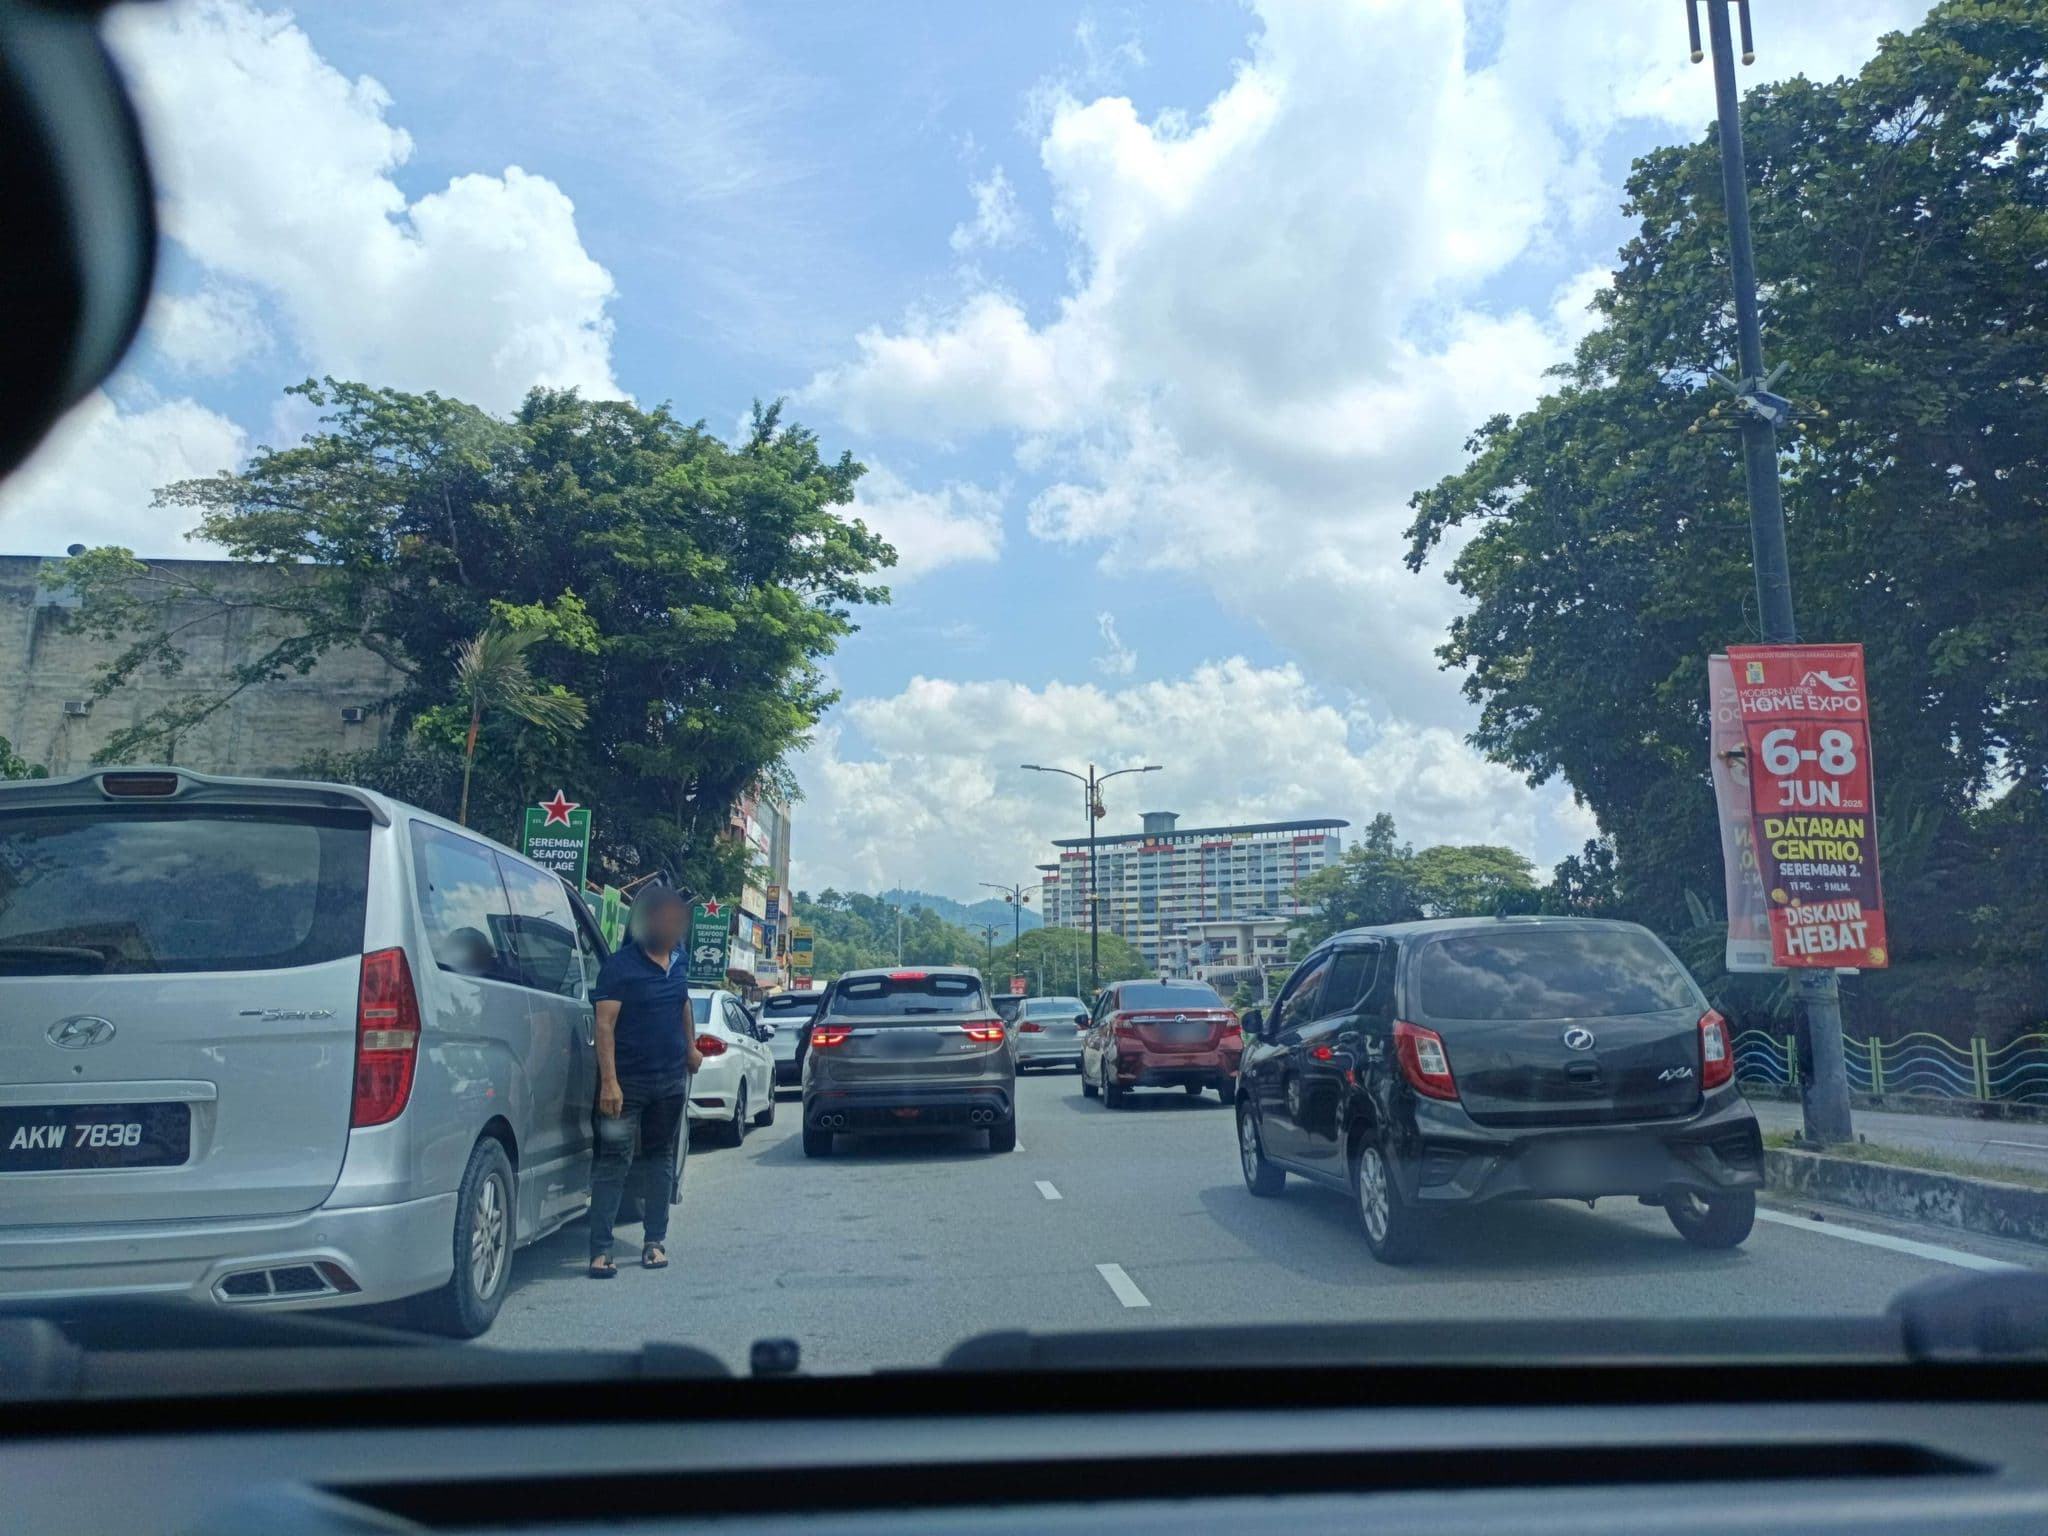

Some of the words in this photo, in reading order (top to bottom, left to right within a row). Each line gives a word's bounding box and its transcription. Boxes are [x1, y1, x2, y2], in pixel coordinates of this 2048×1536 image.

[1740, 687, 1782, 698] MODERN
[1784, 686, 1813, 696] LIVING
[1741, 695, 1805, 713] HOME
[1807, 696, 1861, 712] EXPO
[1761, 728, 1857, 776] 6-8
[1778, 780, 1841, 807] JUN
[1764, 816, 1865, 839] DATARAN
[528, 837, 584, 848] SEREMBAN
[532, 849, 578, 860] SEAFOOD
[1771, 839, 1864, 864] CENTRIO,
[1779, 862, 1847, 877] SEREMBAN
[1849, 864, 1861, 877] 2.
[1784, 901, 1862, 926] DISKAUN
[1785, 922, 1868, 956] HEBAT
[8, 1124, 67, 1150] AKW
[74, 1123, 142, 1148] 7838
